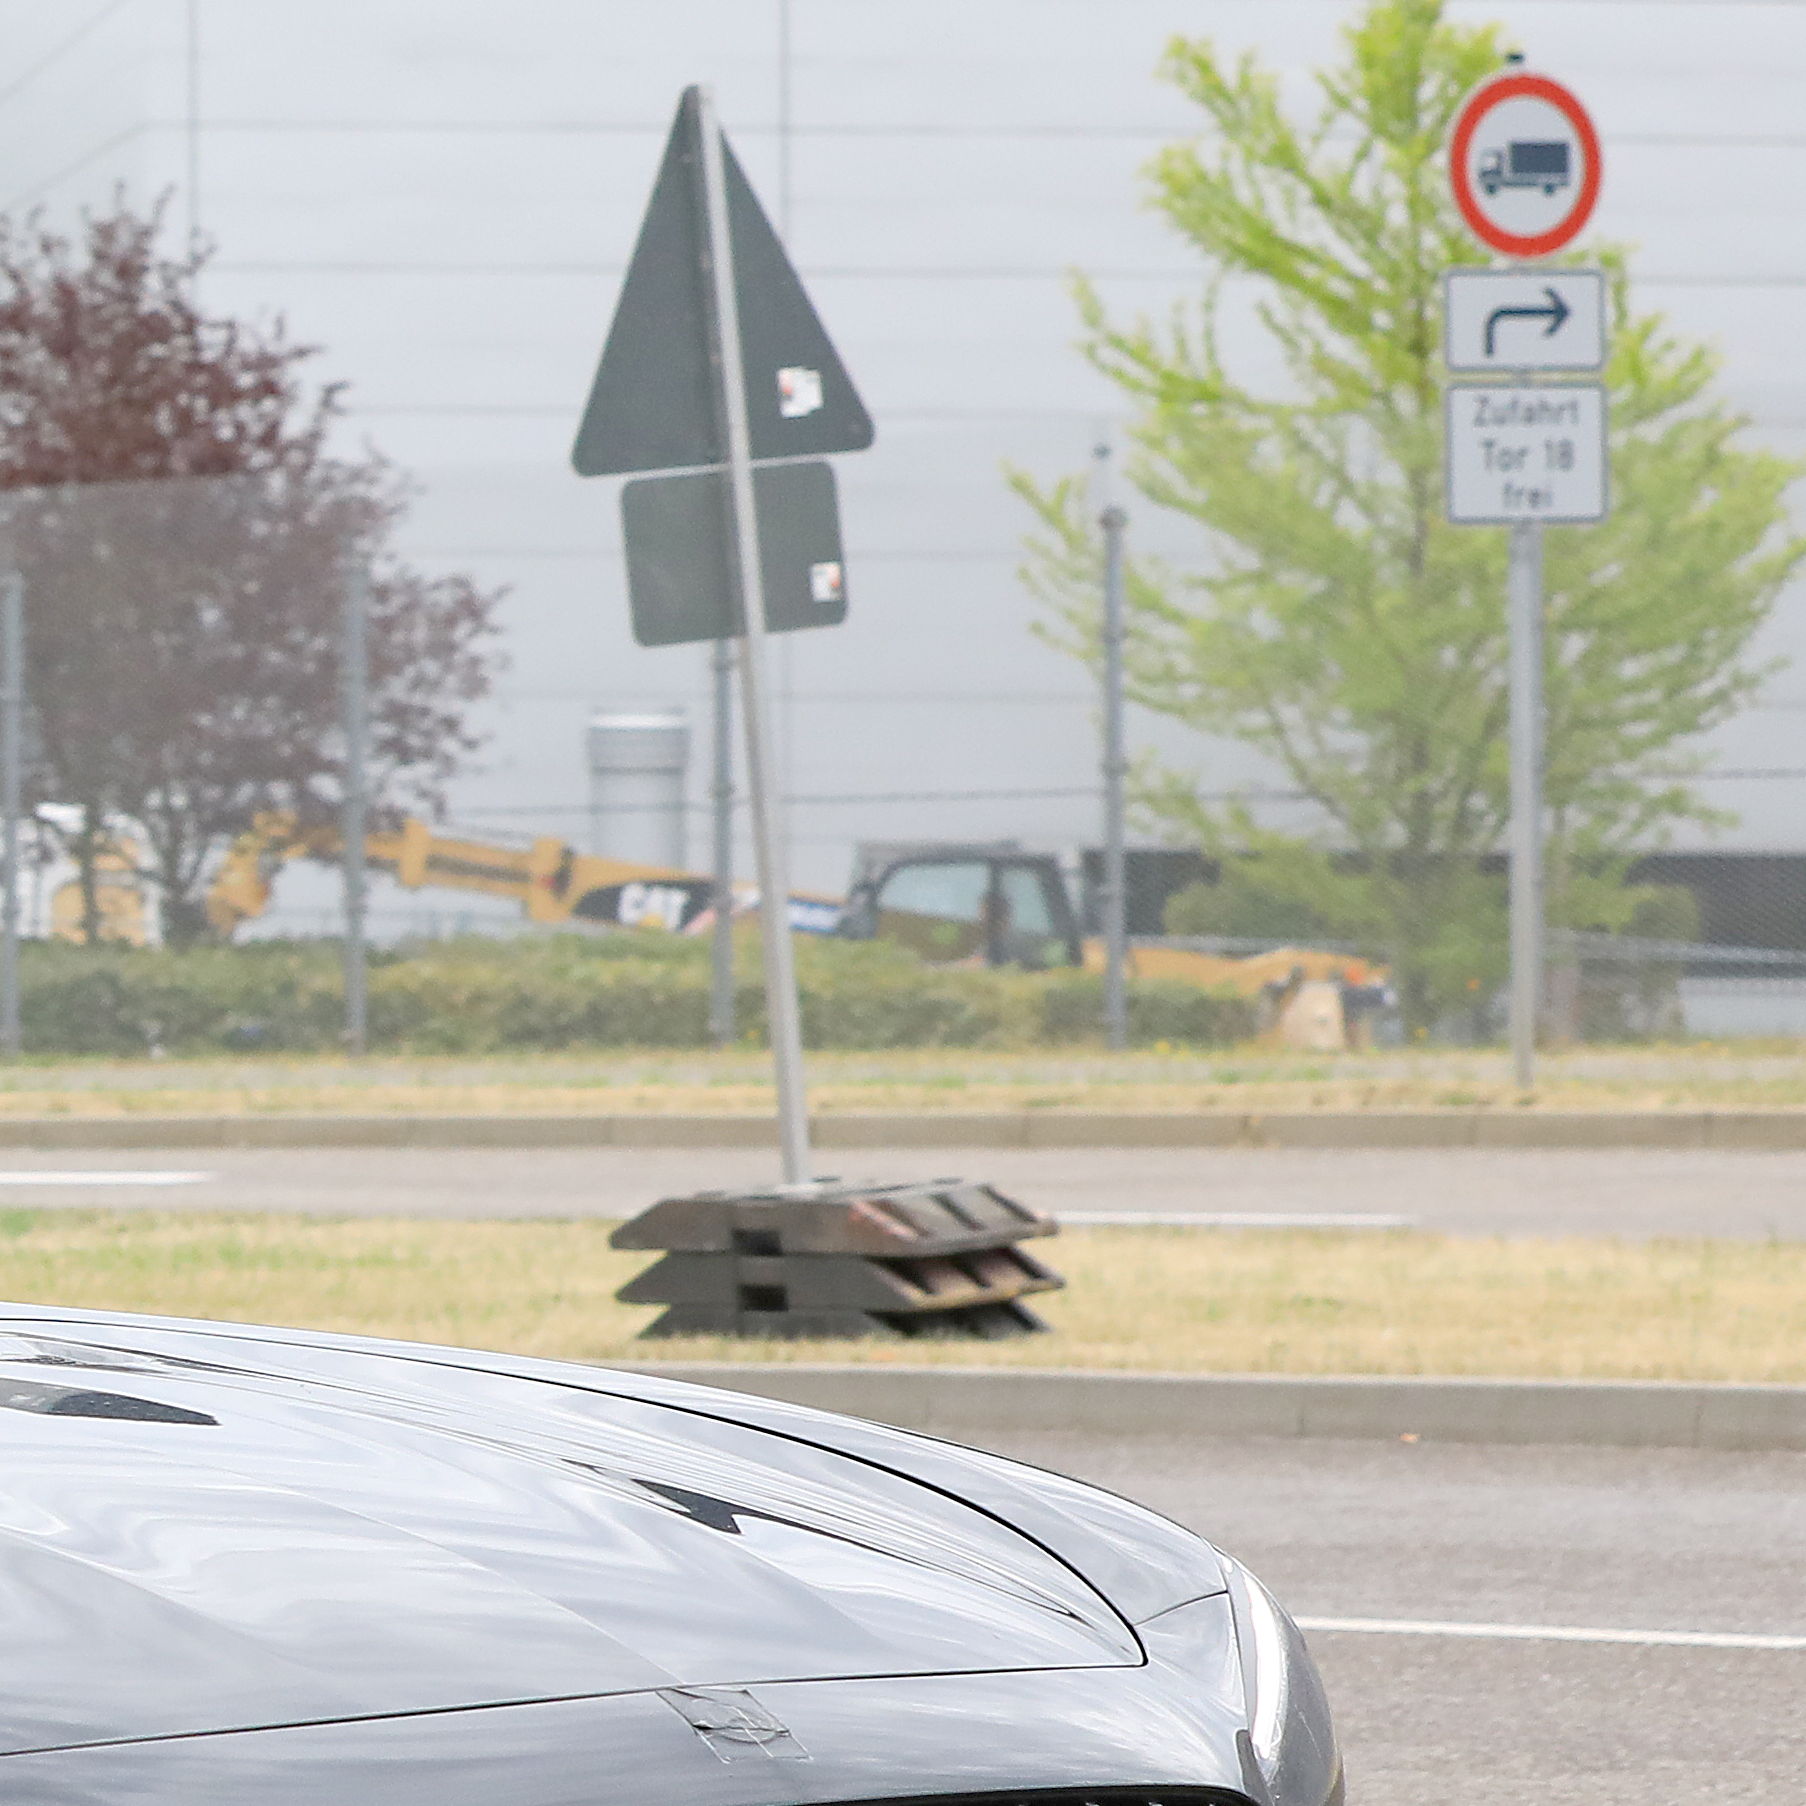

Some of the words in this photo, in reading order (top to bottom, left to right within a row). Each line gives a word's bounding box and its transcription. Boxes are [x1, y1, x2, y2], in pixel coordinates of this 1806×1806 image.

[1472, 396, 1579, 427] Zufahrt
[1480, 437, 1527, 470] Tor
[1544, 438, 1576, 471] 18
[1502, 482, 1553, 508] frei
[617, 883, 688, 930] CAT
